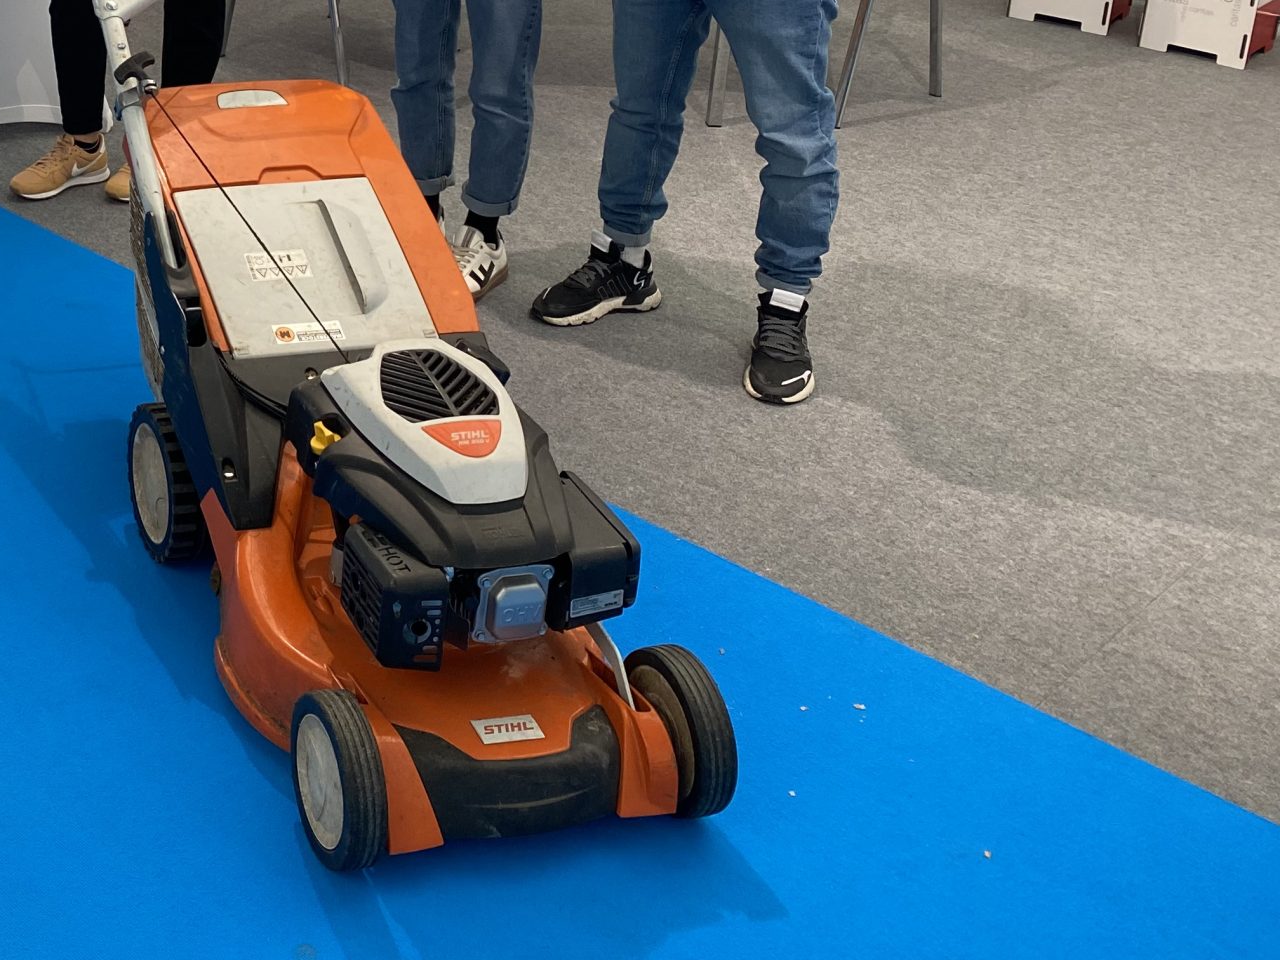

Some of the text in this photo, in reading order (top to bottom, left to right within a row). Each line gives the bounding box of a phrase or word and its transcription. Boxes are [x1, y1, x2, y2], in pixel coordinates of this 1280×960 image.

[451, 430, 489, 441] STIHL
[378, 546, 411, 573] HOT
[503, 601, 543, 624] OHV
[483, 721, 534, 736] STIHL
